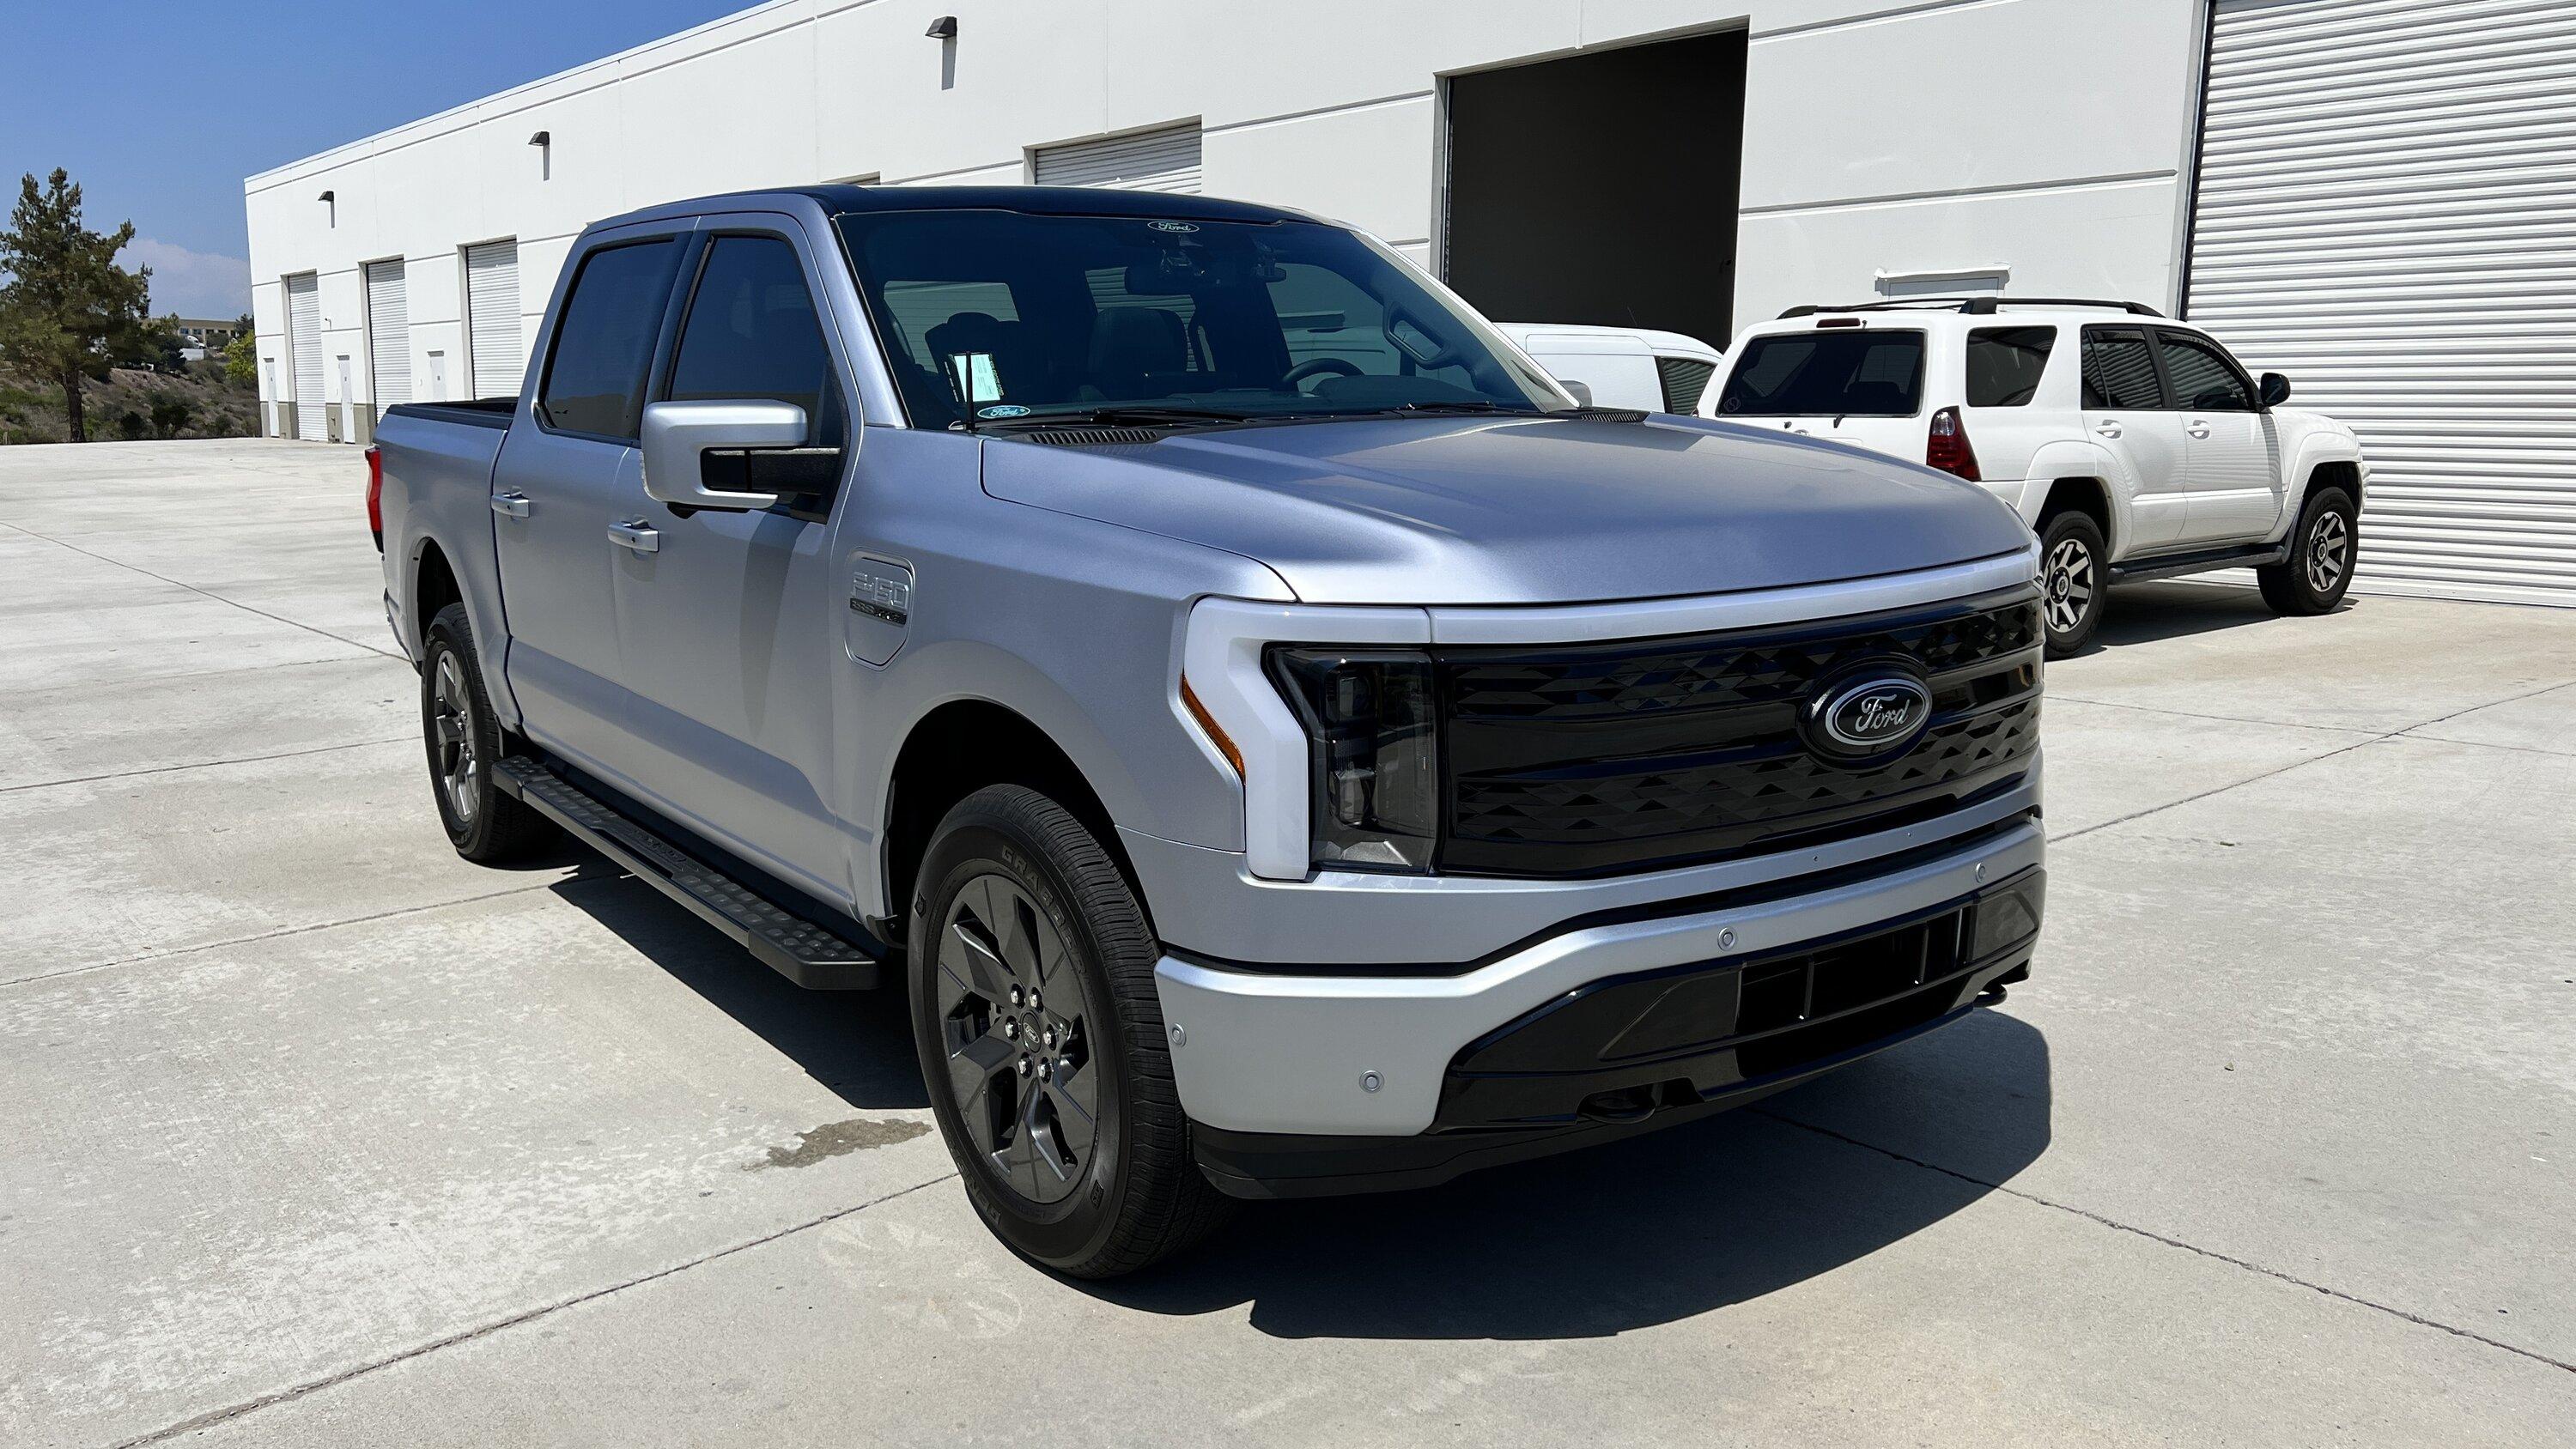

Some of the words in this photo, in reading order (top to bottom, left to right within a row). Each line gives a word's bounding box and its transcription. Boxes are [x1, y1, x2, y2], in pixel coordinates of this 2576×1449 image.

[1157, 222, 1192, 231] Ford
[989, 407, 1019, 417] Ford
[1855, 694, 1911, 732] Ford
[1000, 844, 1087, 974] GRABBER
